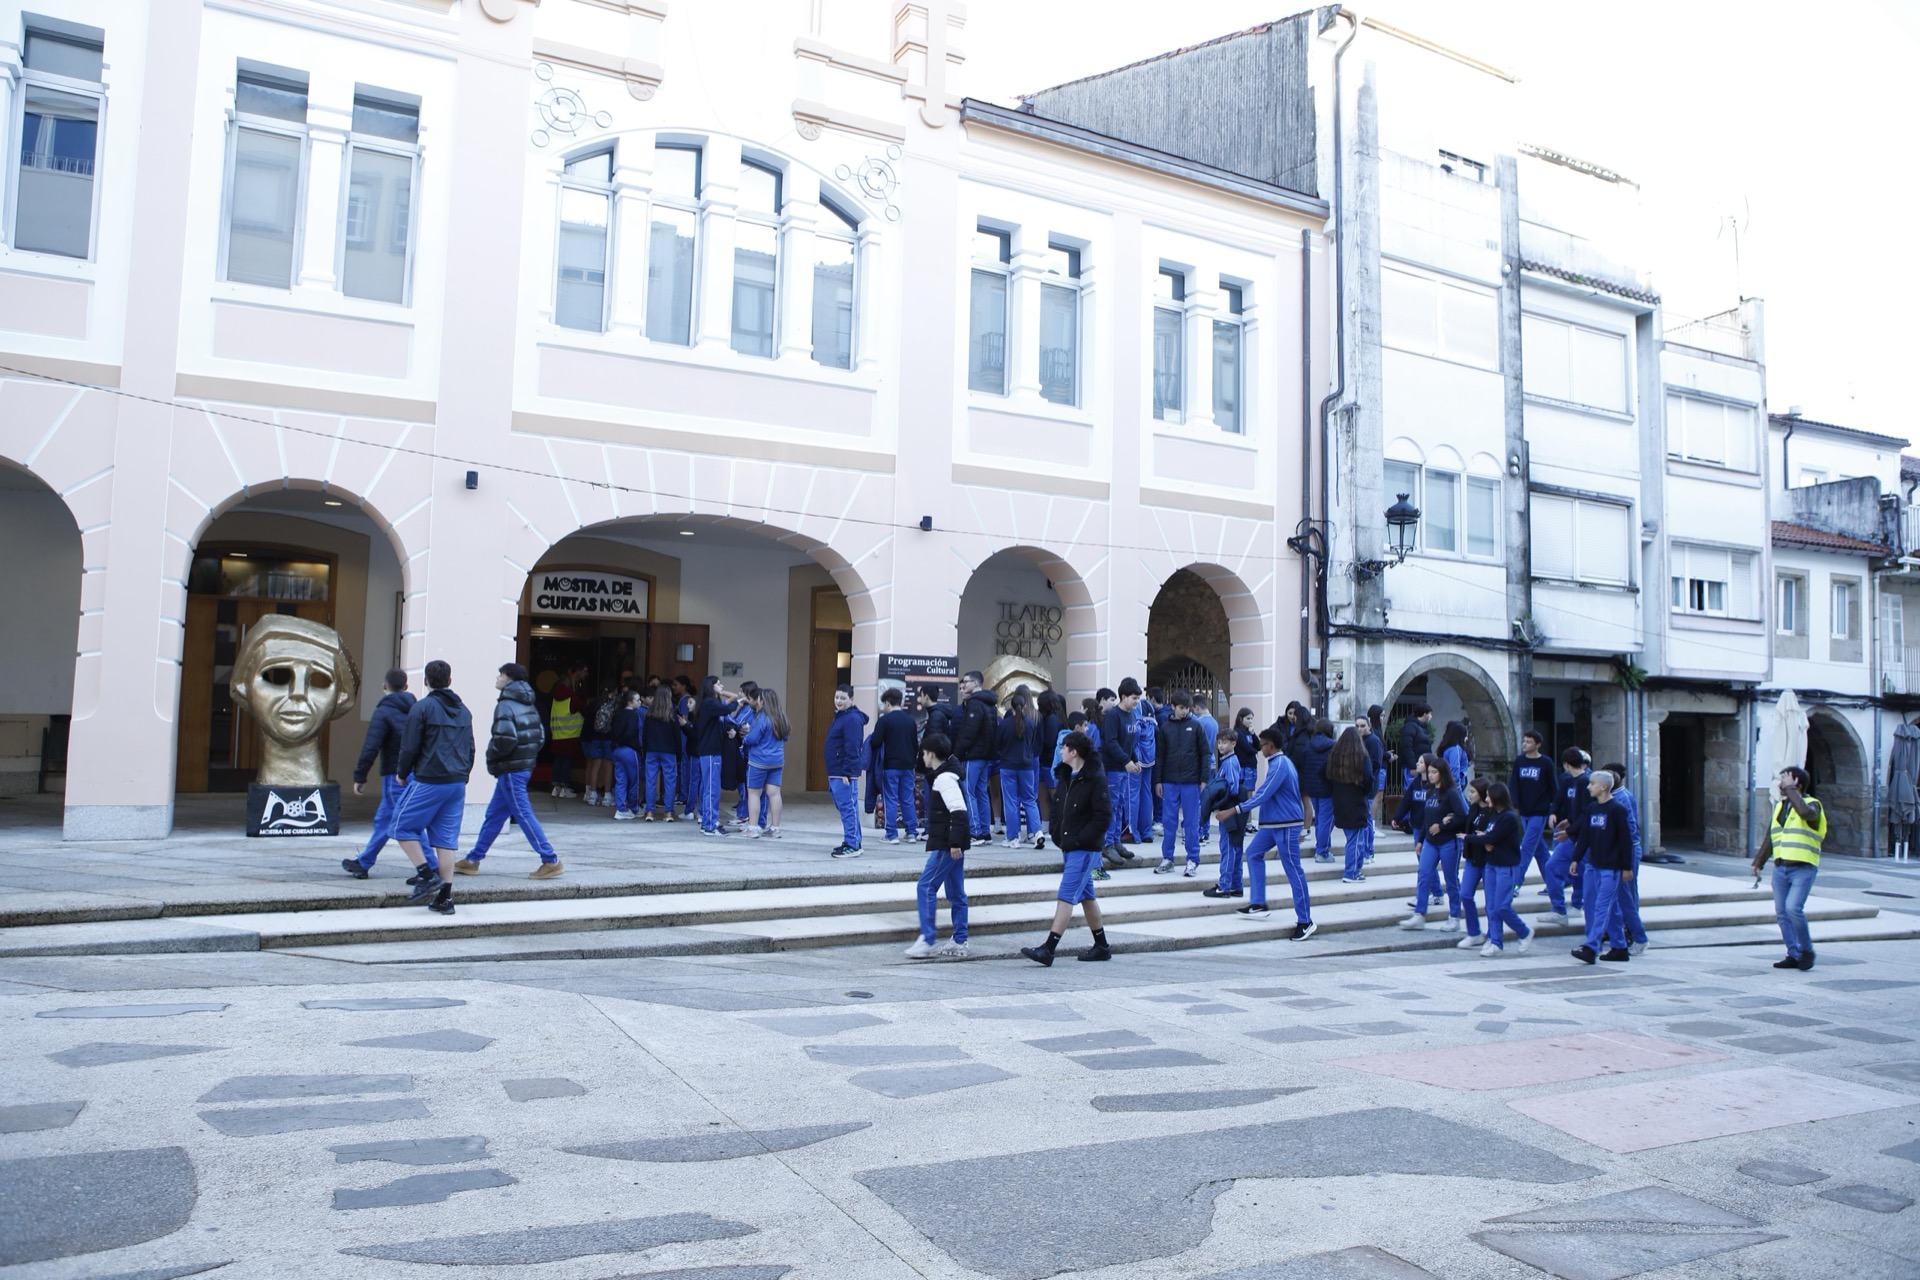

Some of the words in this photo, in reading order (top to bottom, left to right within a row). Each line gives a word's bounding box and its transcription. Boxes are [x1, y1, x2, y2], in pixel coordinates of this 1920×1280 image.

[543, 577, 608, 595] MOSTRA
[611, 582, 633, 596] DE
[536, 595, 597, 612] CURTAS
[599, 598, 640, 614] NOIA
[888, 656, 948, 668] Programación
[926, 666, 956, 675] Cultural
[1521, 768, 1538, 777] CJB
[1590, 816, 1605, 825] CJB
